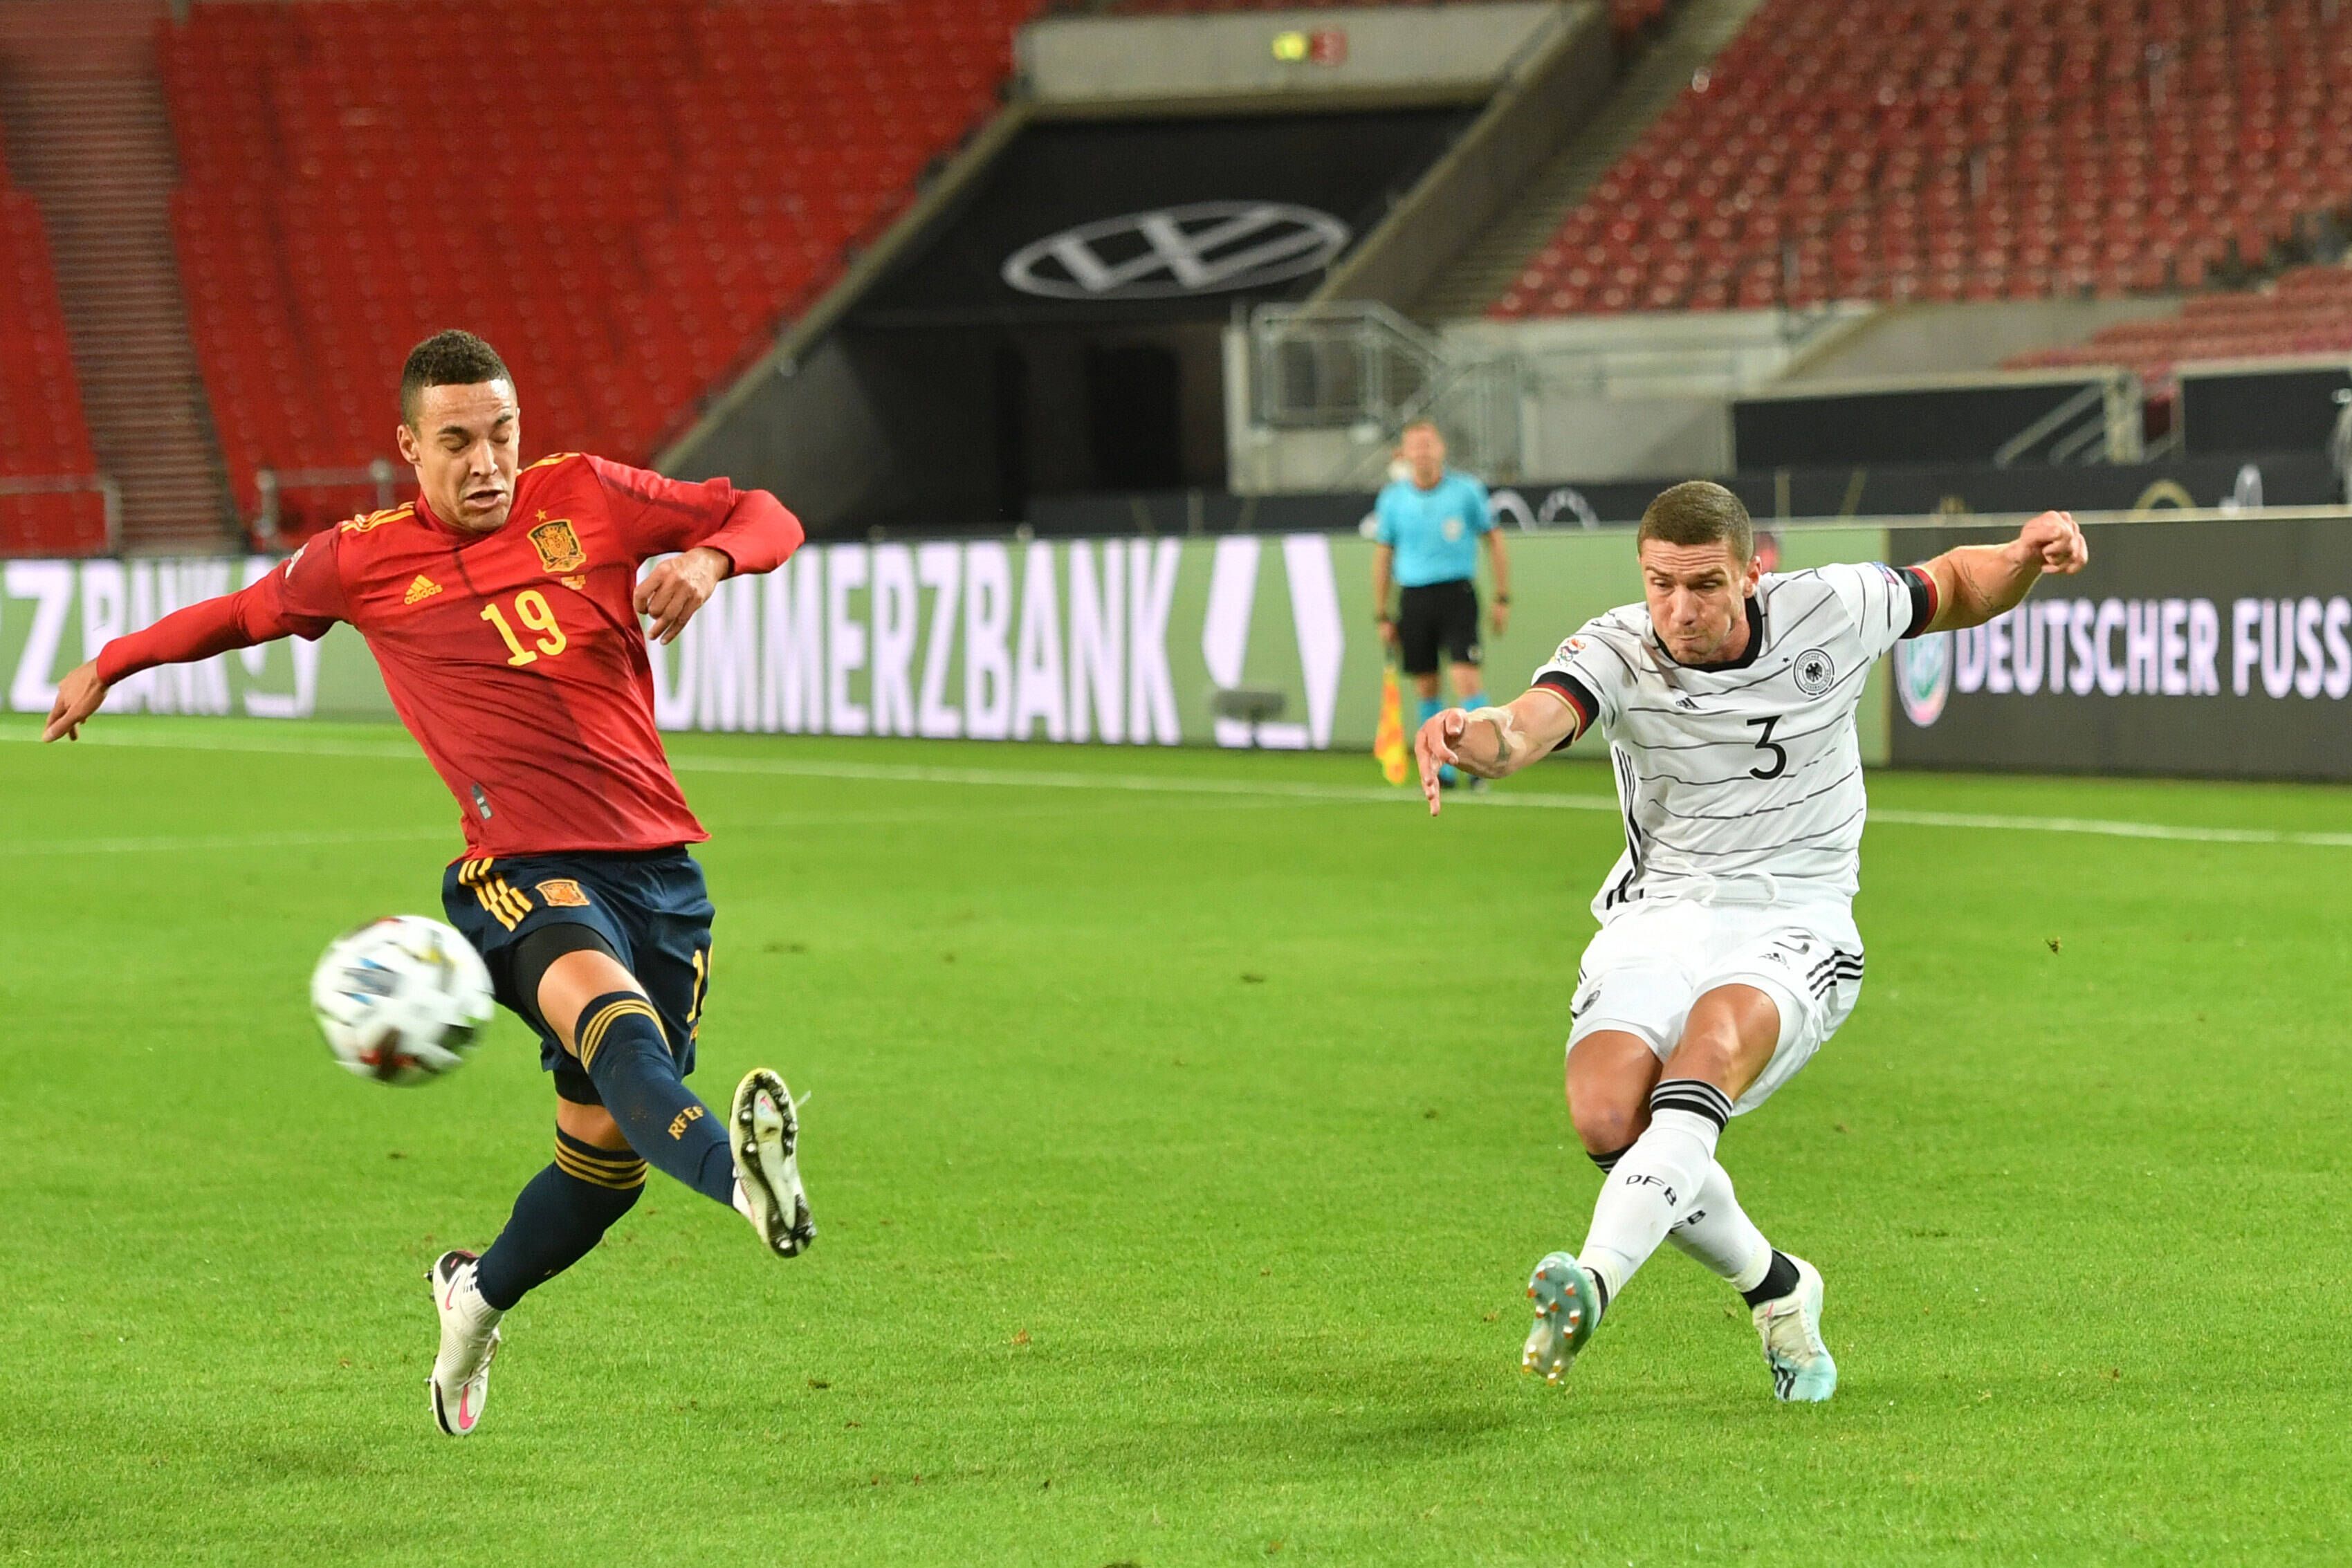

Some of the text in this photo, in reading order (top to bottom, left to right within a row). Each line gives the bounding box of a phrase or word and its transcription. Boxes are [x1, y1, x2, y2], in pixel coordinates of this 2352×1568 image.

[404, 584, 443, 605] adidas
[480, 590, 567, 666] 19
[636, 537, 1181, 746] OMMERZBANK
[1955, 596, 2352, 700] DEUTSCHER FUSS
[1747, 714, 1787, 780] 3
[1626, 1174, 1678, 1207] DFB
